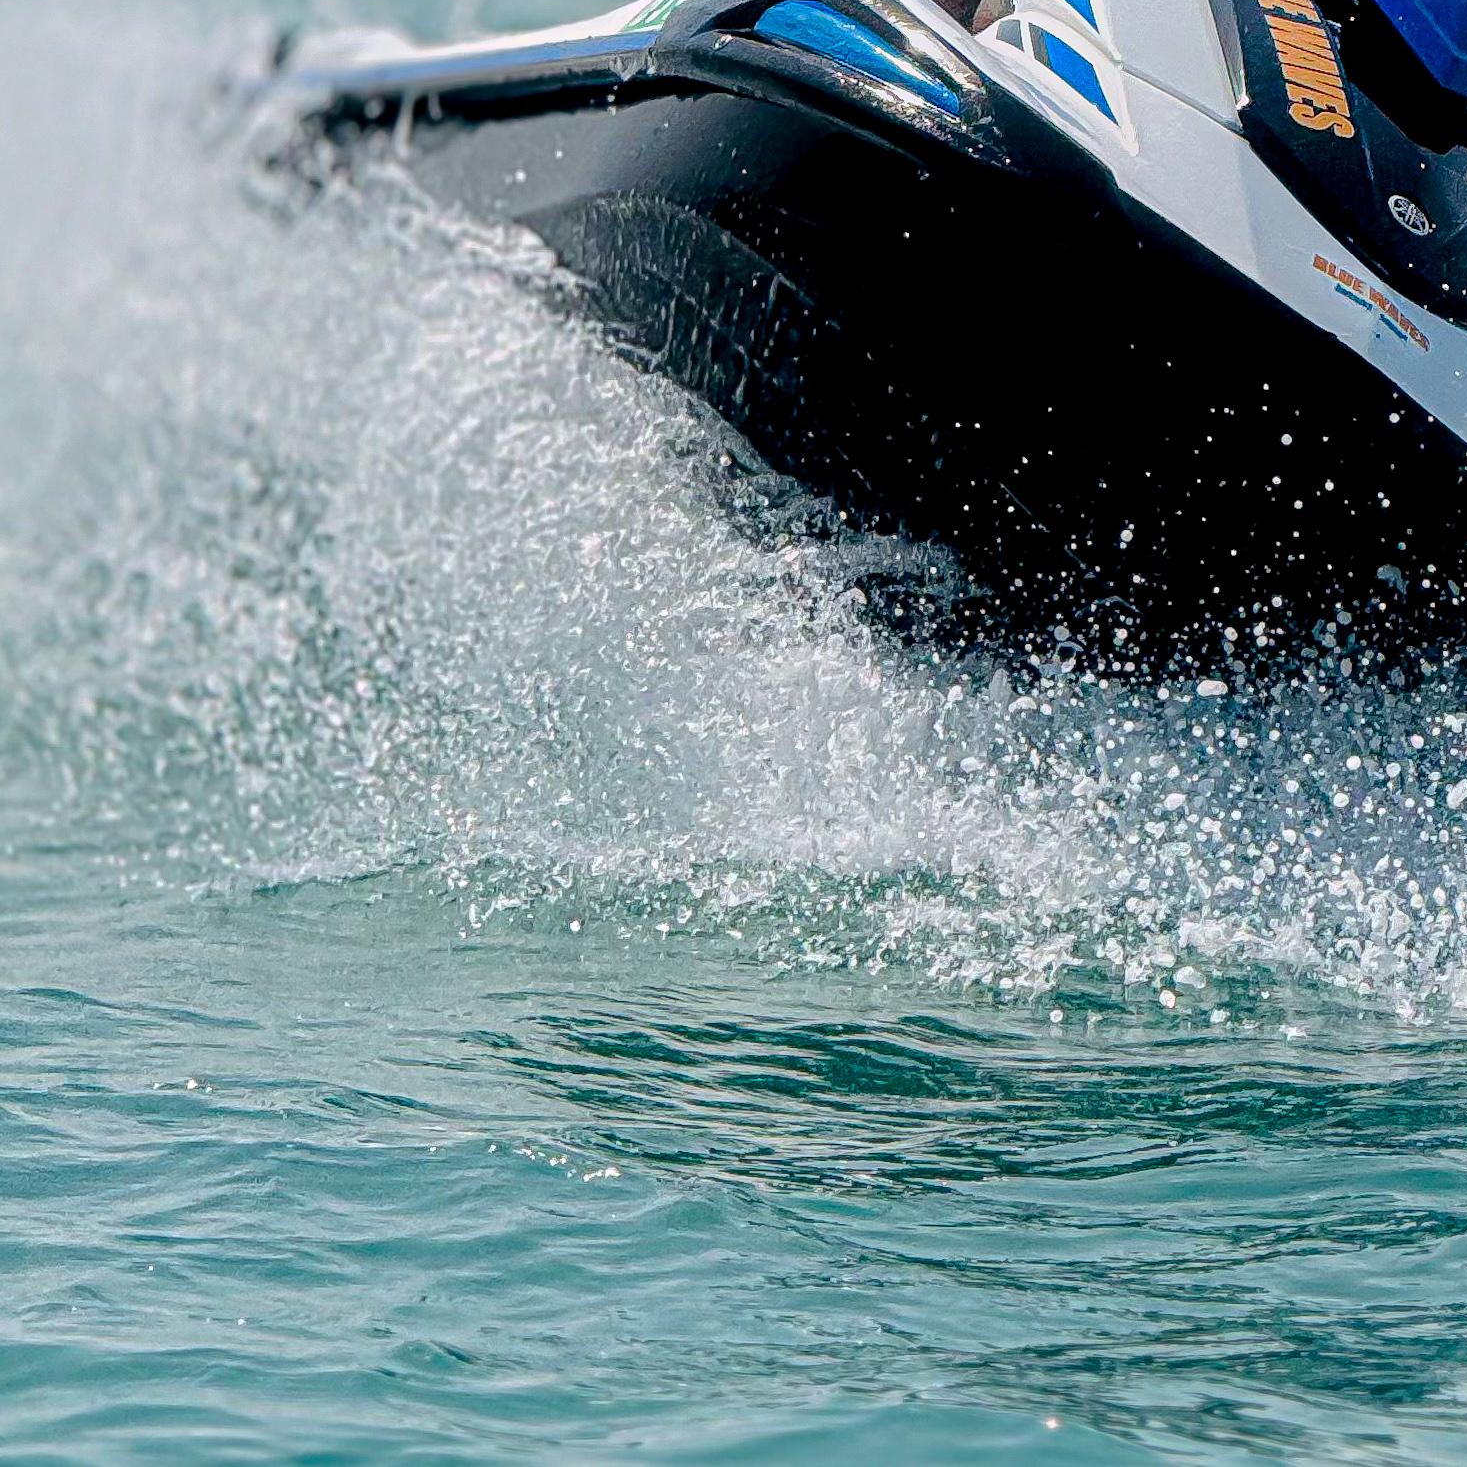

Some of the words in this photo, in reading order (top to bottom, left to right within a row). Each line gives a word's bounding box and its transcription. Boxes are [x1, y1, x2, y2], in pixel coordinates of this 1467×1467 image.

[1263, 13, 1355, 139] WAVES
[1313, 253, 1367, 295] BLUE
[1368, 286, 1431, 352] WAVES
